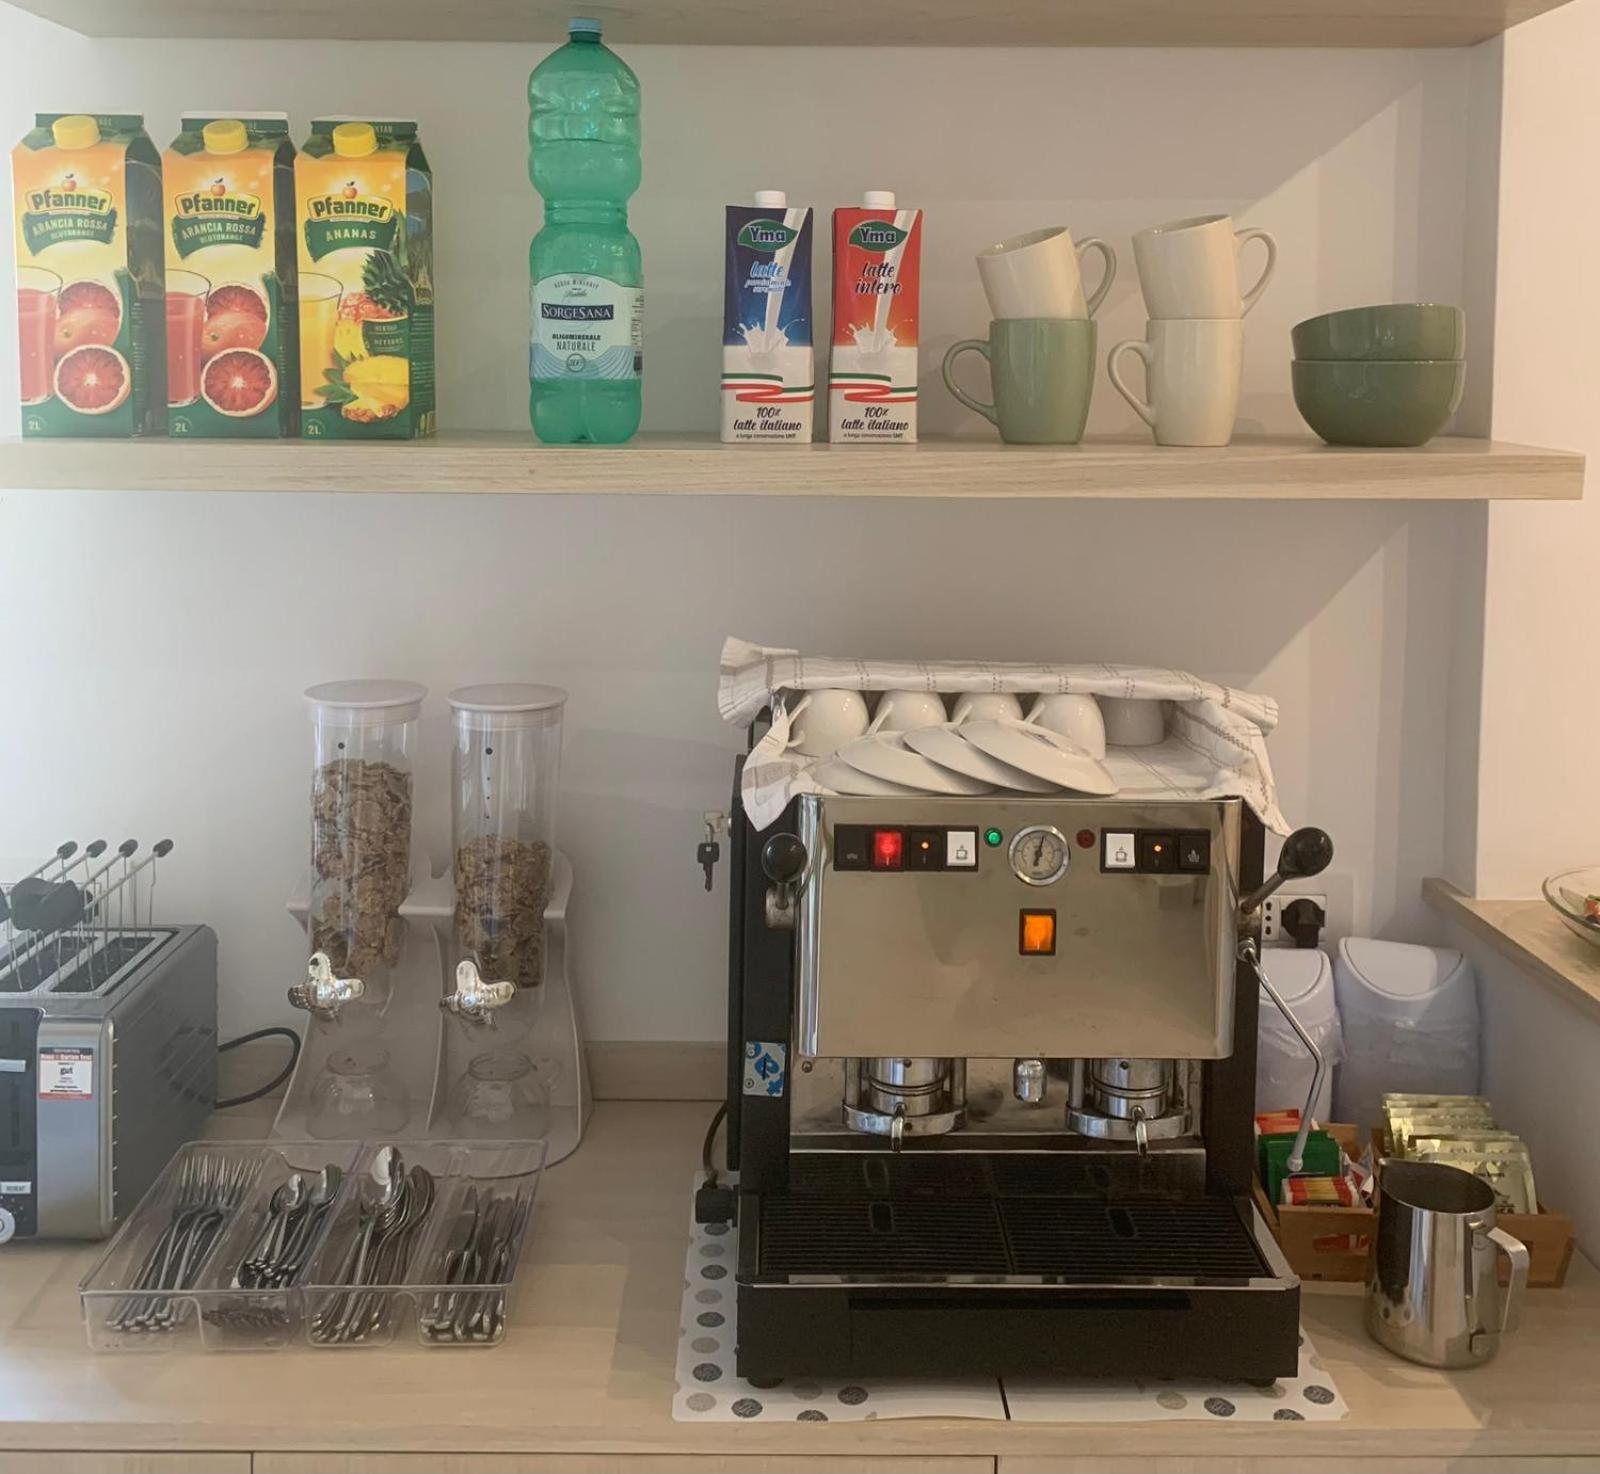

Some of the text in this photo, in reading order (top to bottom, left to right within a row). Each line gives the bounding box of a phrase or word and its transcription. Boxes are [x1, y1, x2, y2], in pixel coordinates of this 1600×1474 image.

[31, 189, 107, 210] Pfanner
[180, 193, 256, 215] Pfanner
[313, 196, 388, 218] Pfanner
[32, 217, 108, 236] ARANCIA ROSSA
[181, 222, 256, 240] ARANCIA ROSSA
[748, 226, 787, 242] Yma
[326, 228, 377, 241] ANANAS
[859, 227, 897, 243] Yma
[750, 261, 785, 278] latte
[862, 262, 895, 278] latte
[855, 279, 902, 294] intero
[543, 304, 611, 319] SORGESANA
[556, 341, 596, 351] NATURALE
[757, 406, 782, 418] 100%
[864, 406, 889, 418] 100%
[28, 420, 41, 431] 2L
[175, 422, 188, 433] 2L
[307, 425, 321, 435] 2L
[733, 419, 802, 431] latte italiano
[841, 418, 909, 431] latte italiano
